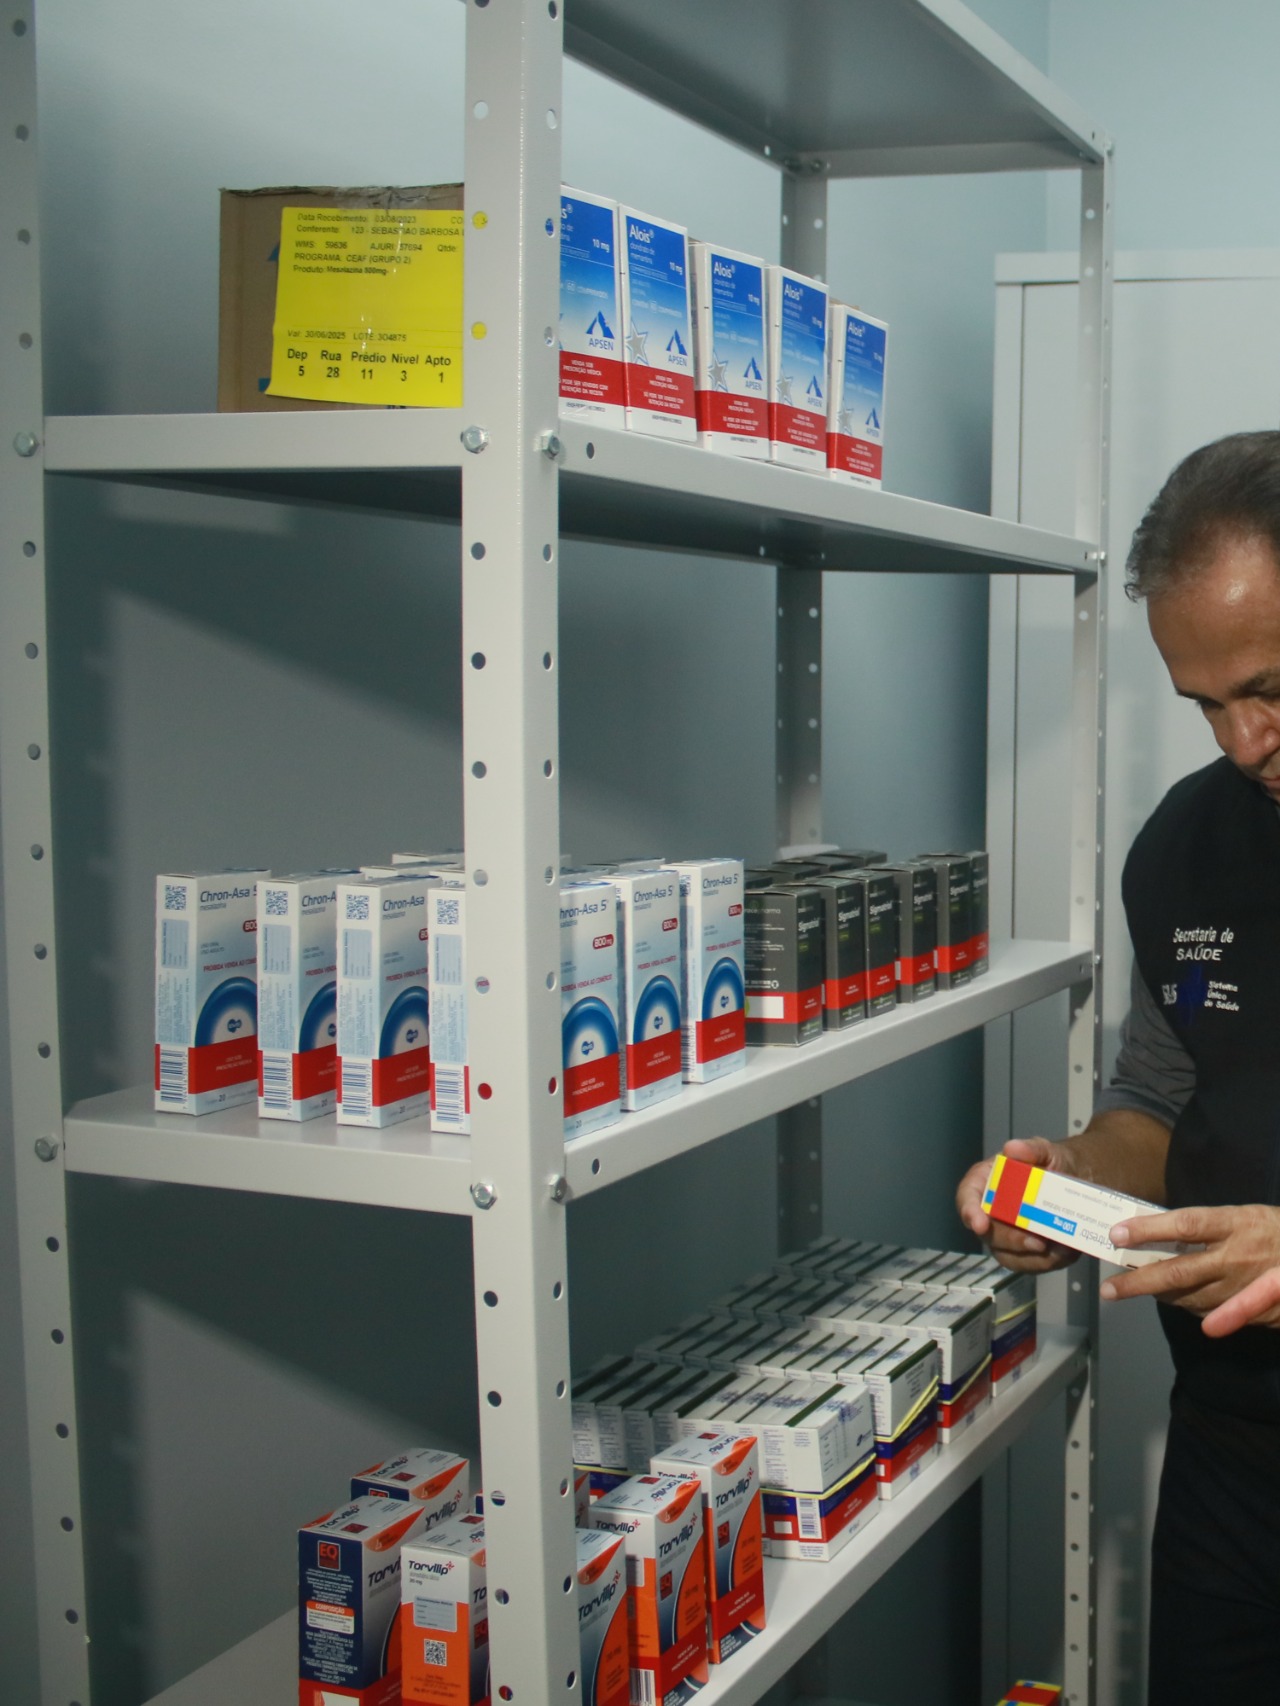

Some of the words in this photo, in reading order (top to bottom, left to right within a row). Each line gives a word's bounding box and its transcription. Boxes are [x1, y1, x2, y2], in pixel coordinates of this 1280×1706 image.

[592, 239, 600, 249] 10
[600, 242, 610, 253] mg
[589, 338, 614, 351] APSEN
[287, 348, 308, 360] Dep
[320, 350, 342, 361] Rua
[425, 355, 452, 366] Apto
[668, 354, 687, 367] APSEN
[298, 366, 305, 377] 5
[326, 367, 340, 378] 28
[361, 368, 373, 380] 11
[400, 370, 407, 382] 3
[438, 372, 444, 383] 1
[745, 380, 762, 391] APSEN
[702, 876, 732, 888] Chron-Asa
[200, 887, 250, 902] Chron-Asa
[302, 891, 336, 907] Chron-A
[634, 888, 666, 903] Chron-Asa
[667, 885, 673, 896] 5
[383, 896, 424, 911] Chron-Asa
[560, 903, 598, 919] hron-Asa
[601, 900, 608, 911] 5
[1172, 926, 1217, 943] Secretaria
[1220, 927, 1234, 943] de
[1176, 943, 1223, 961] SAÚDE
[1208, 980, 1238, 992] Sistema
[1207, 989, 1227, 1000] Único
[1204, 999, 1213, 1007] de
[1216, 1000, 1239, 1012] Saúde
[1053, 1216, 1063, 1226] mg
[1062, 1221, 1075, 1233] 100
[716, 1477, 750, 1508] Torvilip
[596, 1520, 635, 1534] Torvilip
[659, 1523, 693, 1558] Torvilip
[320, 1544, 337, 1560] EQ
[409, 1560, 449, 1576] Torvilip
[579, 1580, 616, 1621] Torvilip
